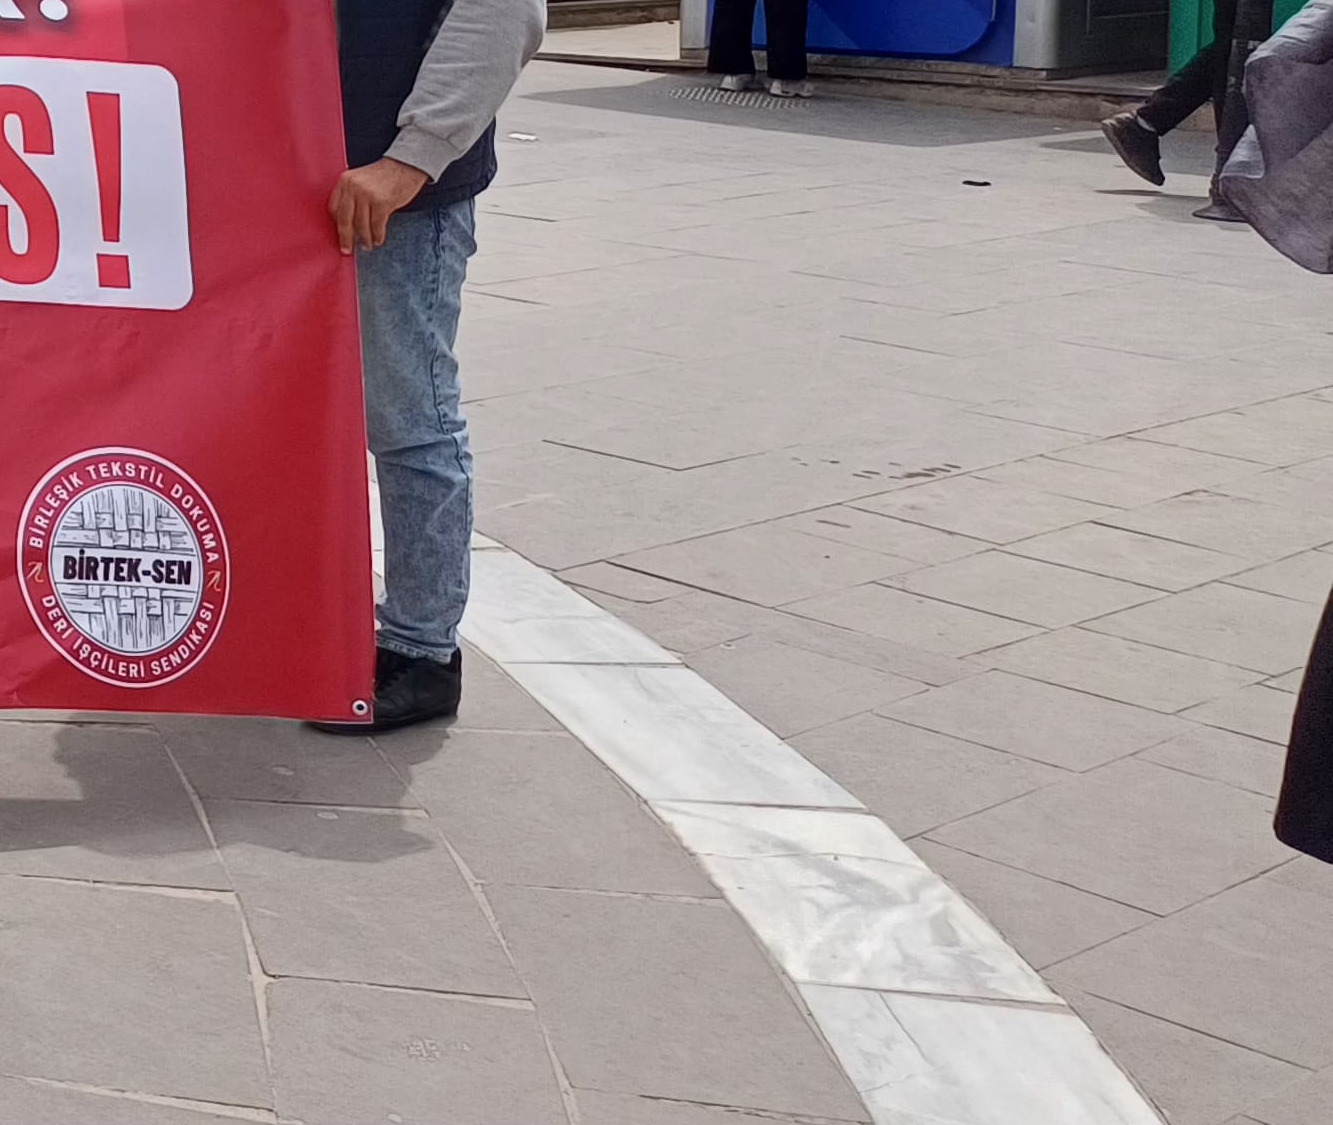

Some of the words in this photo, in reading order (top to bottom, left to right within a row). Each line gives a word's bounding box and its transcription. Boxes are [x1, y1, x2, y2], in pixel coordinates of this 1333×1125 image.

[29, 472, 84, 549] BİRLEŞİK
[86, 461, 165, 488] TEKSTİL
[170, 483, 220, 564] DOKUMA
[62, 549, 193, 585] BİRTEK-SEN
[150, 602, 215, 676] SENDİKASI
